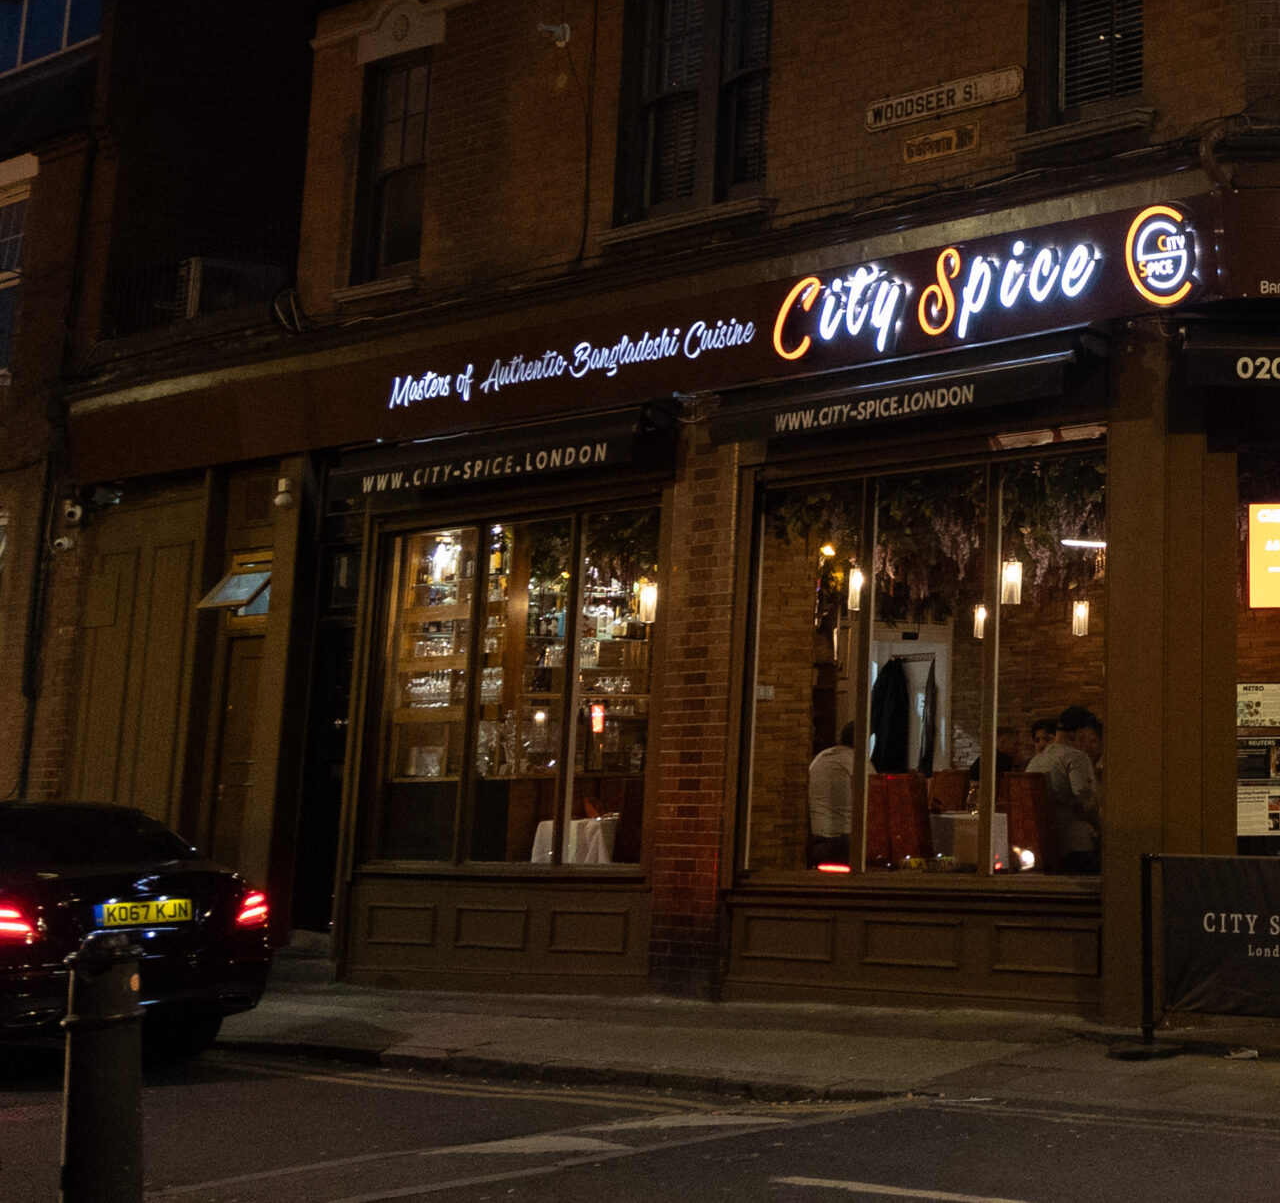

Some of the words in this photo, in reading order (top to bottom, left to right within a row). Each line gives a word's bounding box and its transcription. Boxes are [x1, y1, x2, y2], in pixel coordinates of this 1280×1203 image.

[872, 88, 956, 124] WOODSEER
[1138, 259, 1174, 278] SPICE
[773, 265, 901, 360] City
[918, 240, 1098, 338] Spice
[388, 371, 450, 409] Masters
[456, 363, 474, 402] of
[480, 350, 566, 394] Authentic
[568, 328, 680, 378] Bangladeshi
[683, 318, 756, 360] Cuisine
[774, 383, 975, 433] WWW.CITY-SPICE.LONDON
[362, 442, 607, 494] WWW.CITY-SPICE.LONDON
[1248, 739, 1276, 747] REUTERS
[155, 902, 188, 919] KJN
[1203, 912, 1259, 935] CITY
